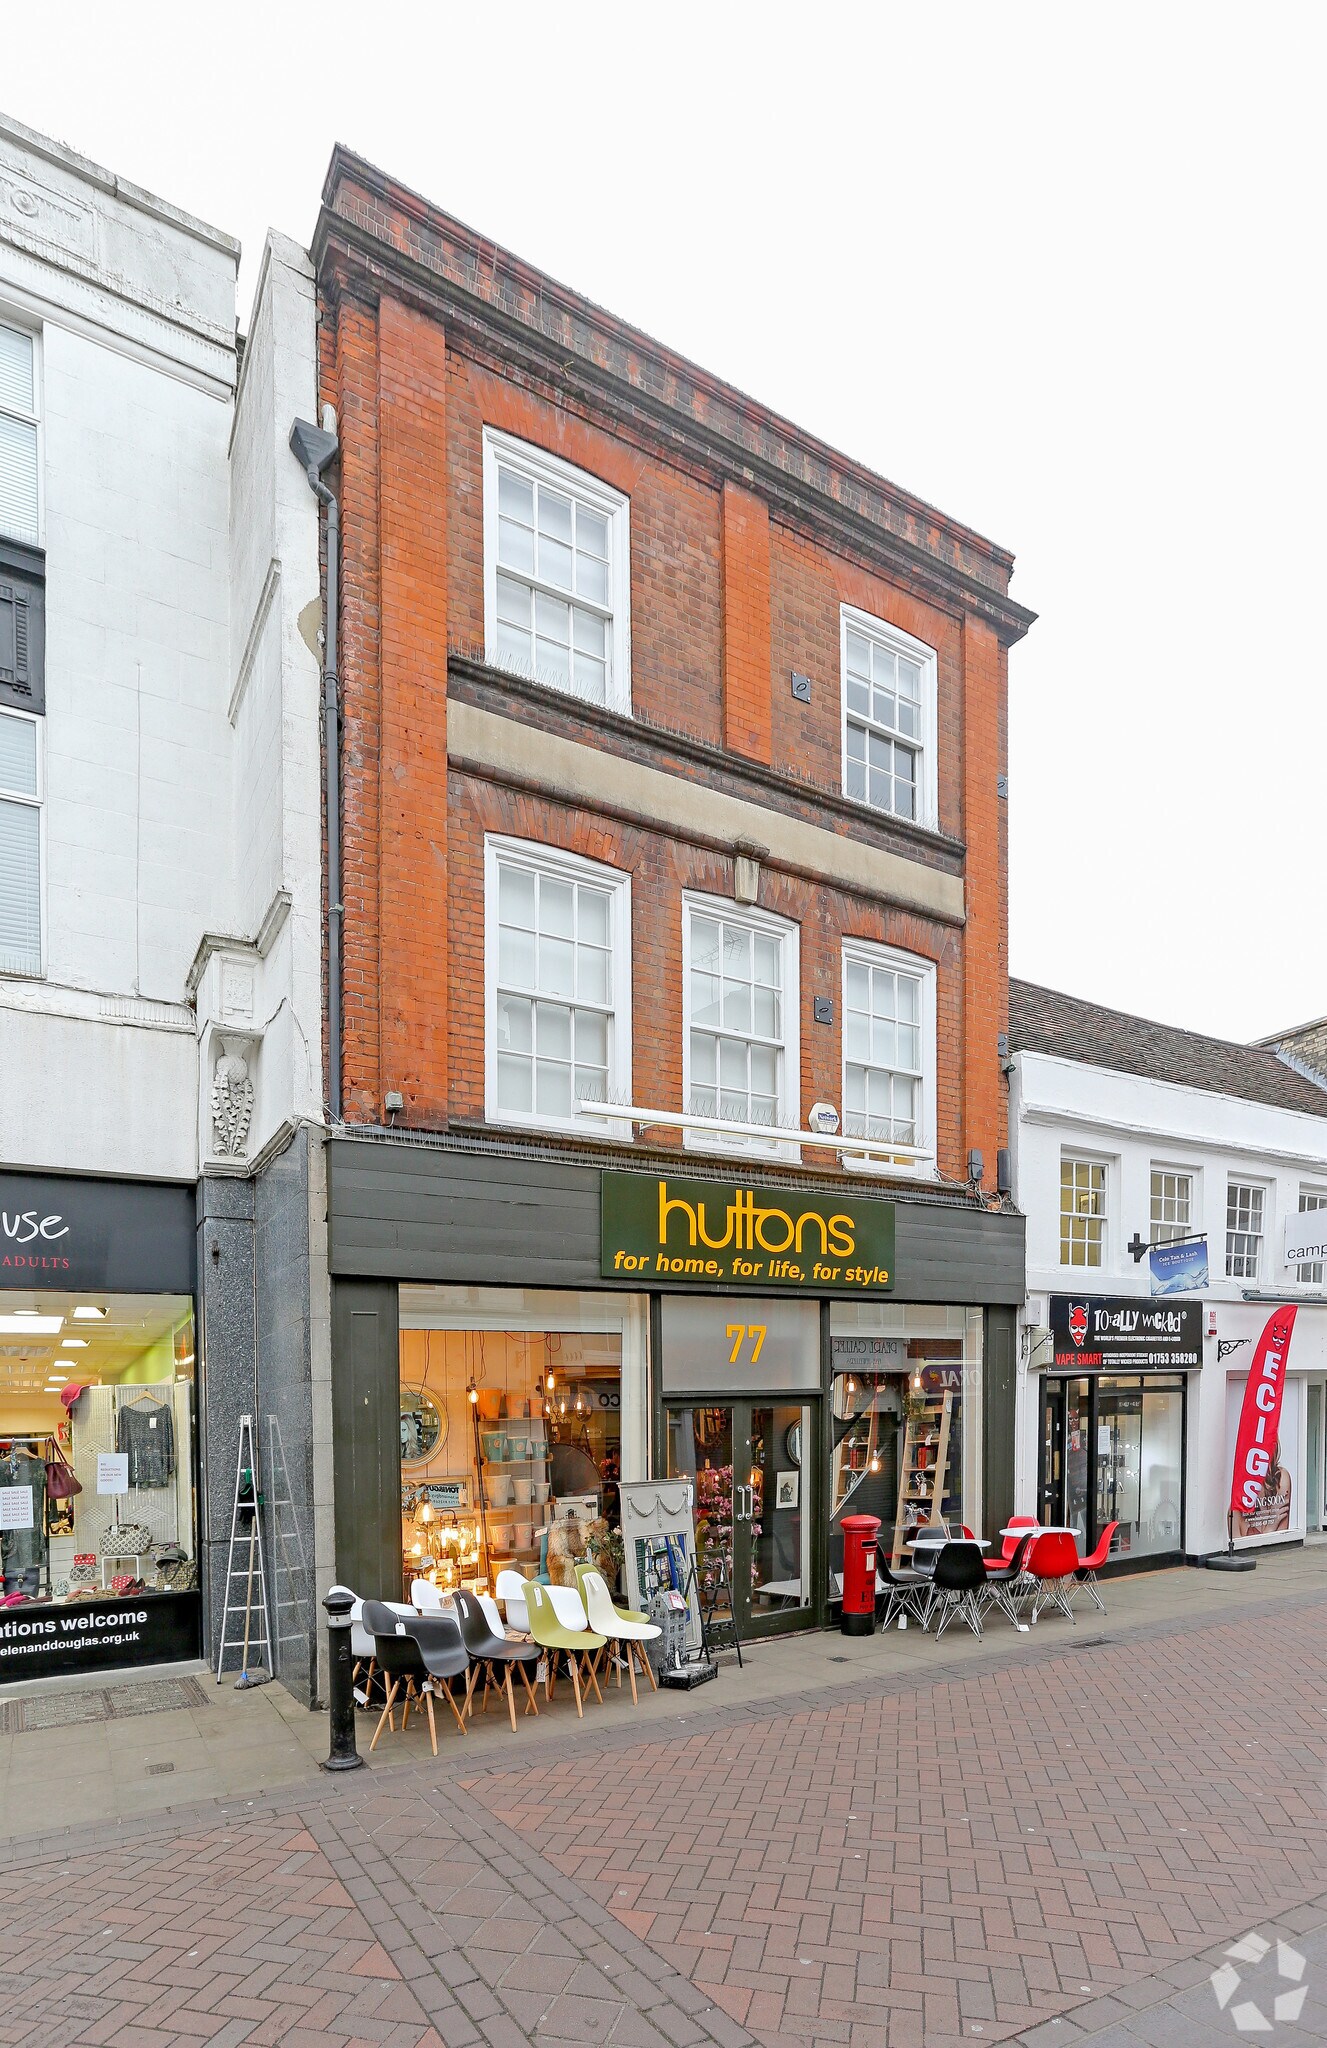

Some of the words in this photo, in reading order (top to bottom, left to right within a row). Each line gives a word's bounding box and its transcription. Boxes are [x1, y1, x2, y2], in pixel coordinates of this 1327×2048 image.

[2, 1210, 70, 1243] use
[658, 1181, 856, 1257] huttons
[2, 1255, 70, 1269] ADULTS
[614, 1250, 650, 1271] for
[655, 1252, 724, 1278] home,
[732, 1257, 763, 1276] for
[768, 1259, 806, 1281] life,
[812, 1262, 841, 1281] for
[845, 1265, 889, 1286] style
[725, 1324, 768, 1364] 77
[1055, 1353, 1075, 1365] VAPE
[1077, 1353, 1103, 1365] SMART
[1148, 1352, 1170, 1365] 01753
[1267, 1494, 1286, 1506] SOON
[60, 1610, 148, 1631] welcome
[0, 1631, 140, 1656] elenanddouglas.org.uk
